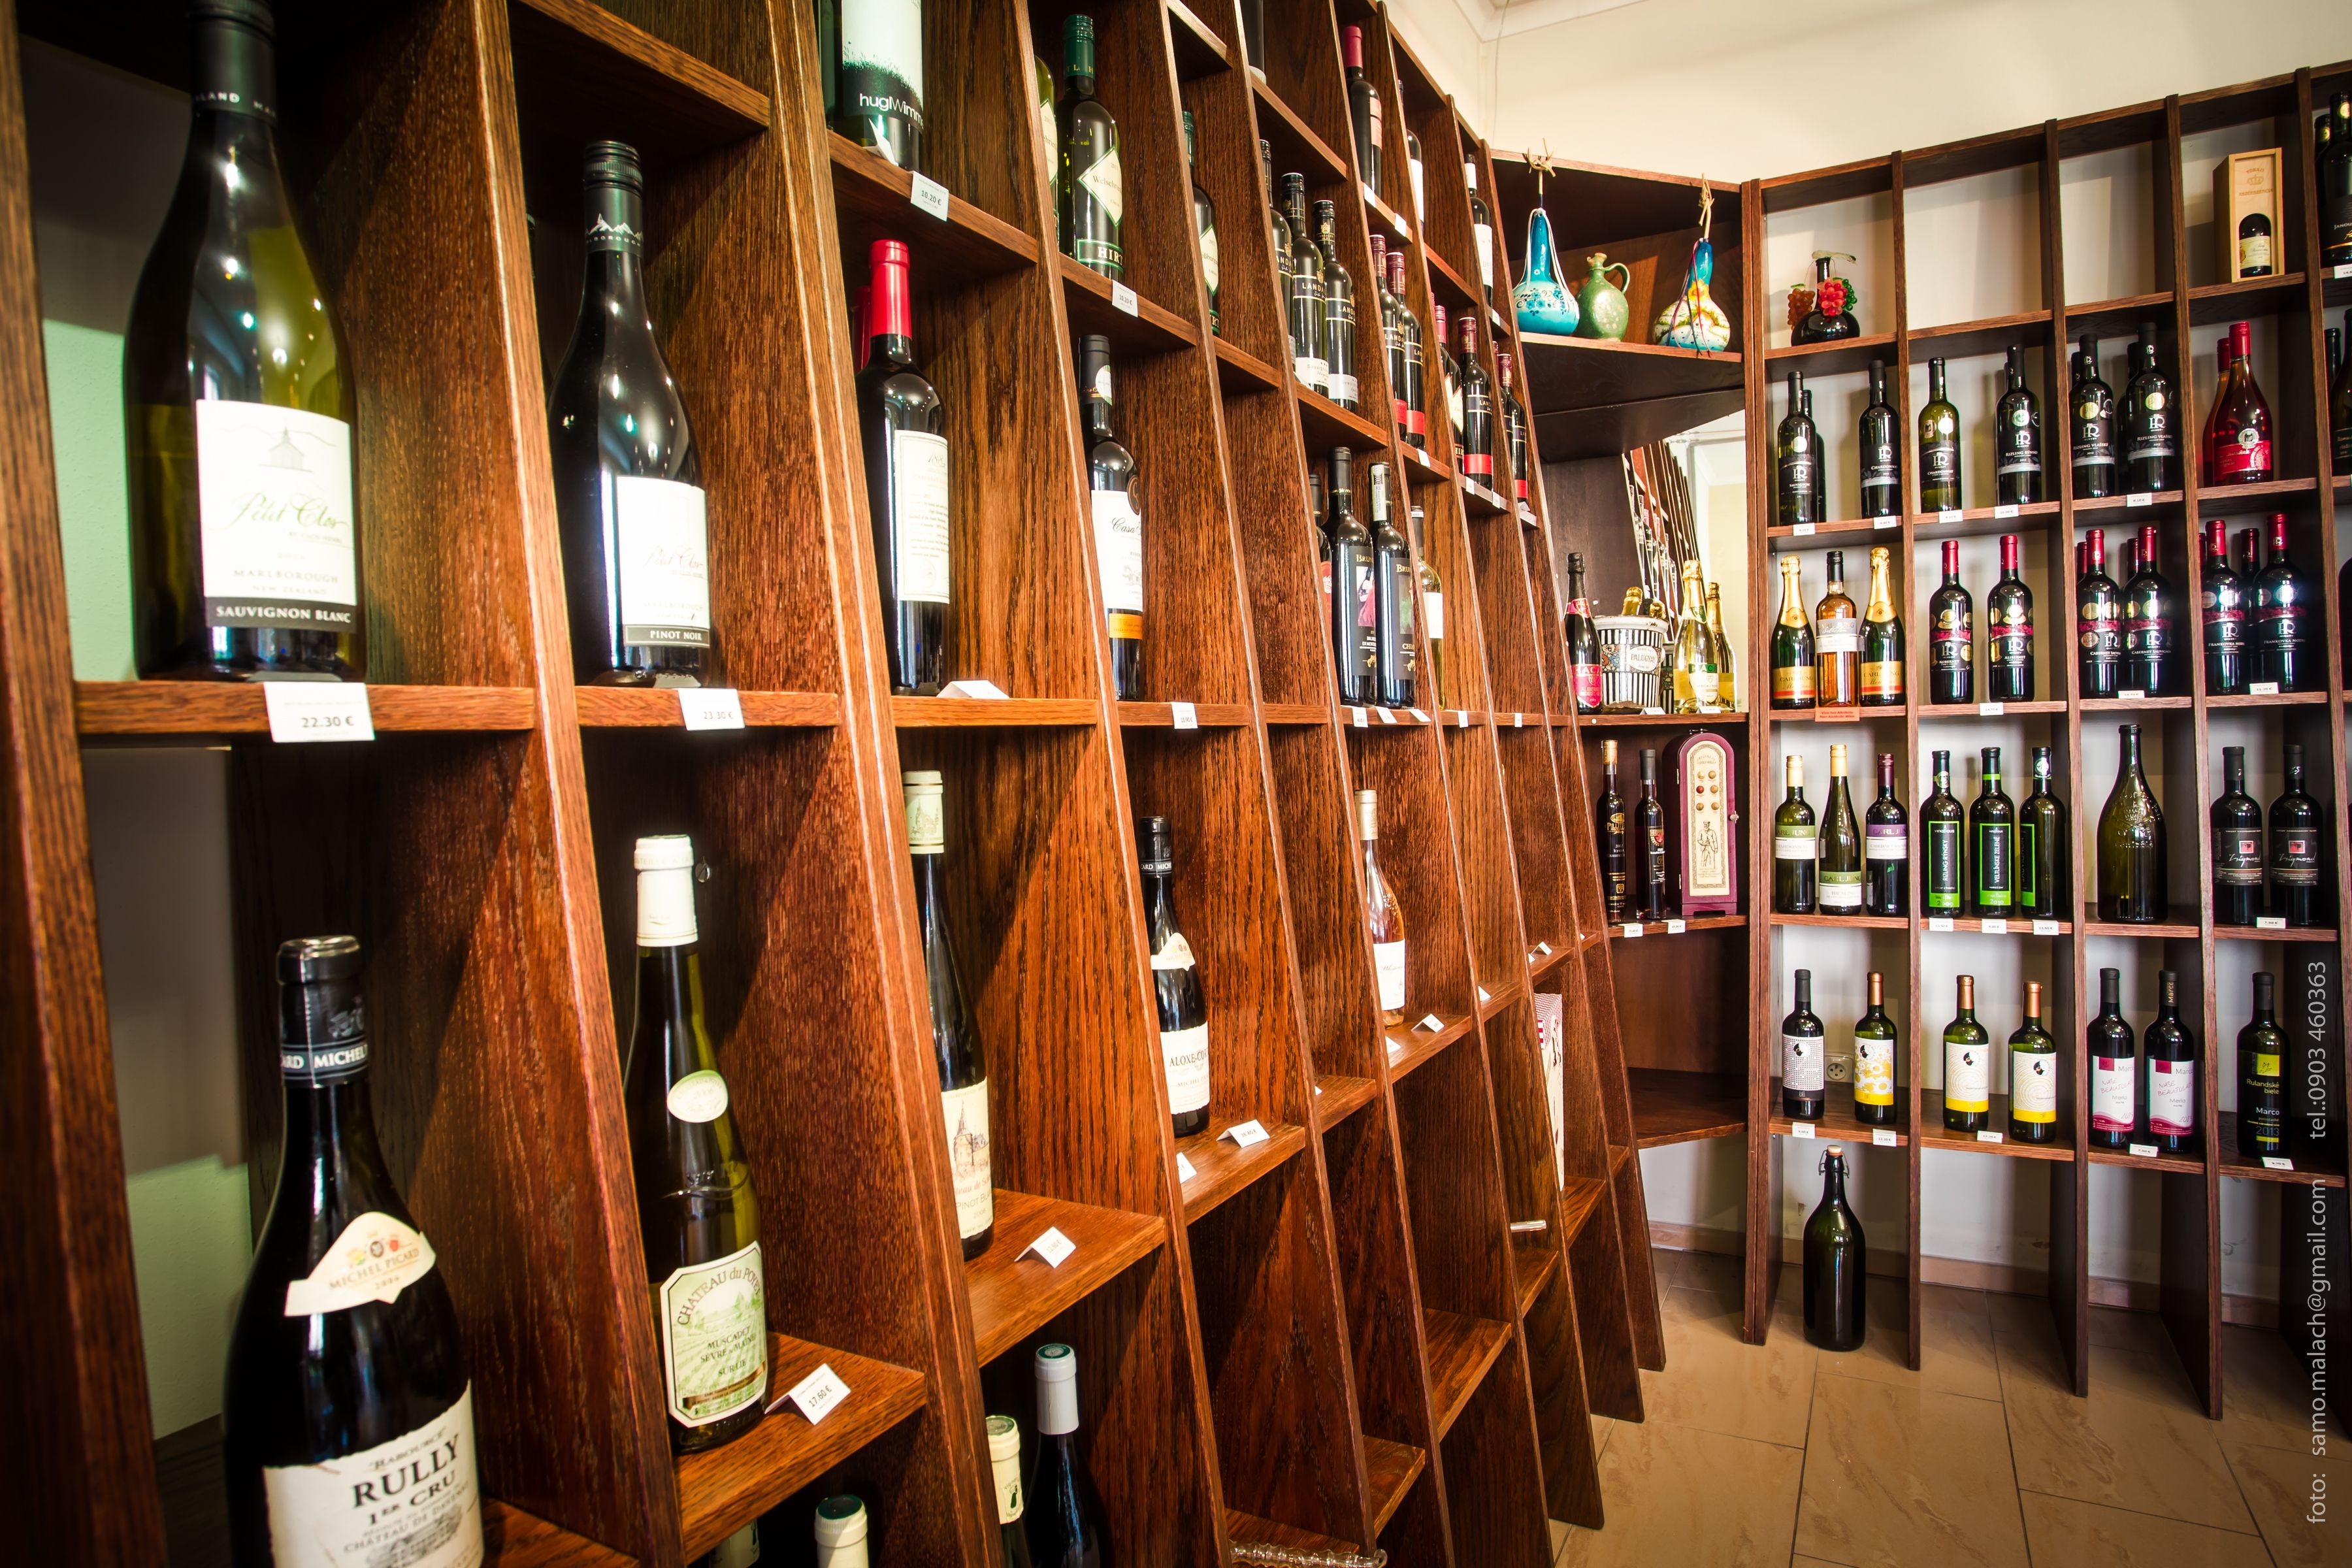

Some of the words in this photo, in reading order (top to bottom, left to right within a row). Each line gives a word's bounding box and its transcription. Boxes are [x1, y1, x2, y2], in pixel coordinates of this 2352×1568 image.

[921, 189, 937, 204] 10.20
[290, 491, 349, 530] Clos
[233, 569, 338, 583] MARLBOROUGH
[216, 606, 310, 619] SAUVIGNON
[316, 610, 351, 623] BLANC
[650, 630, 680, 640] PINOT
[683, 631, 702, 640] NOIR
[301, 715, 342, 728] 22.30
[345, 715, 355, 727] €
[703, 711, 727, 720] 23.30
[2246, 1078, 2279, 1088] Rulandské
[2256, 1107, 2279, 1116] Marco
[2255, 1125, 2279, 1137] 2013
[329, 1260, 382, 1292] MICHEL
[385, 1249, 419, 1271] PICARD
[678, 1267, 727, 1326] CHATEAU
[729, 1267, 742, 1281] du
[707, 1325, 752, 1350] MUSCADET
[718, 1364, 735, 1377] SUR
[736, 1358, 747, 1371] LIE
[808, 1389, 828, 1408] 17.60
[351, 1432, 459, 1509] RULLY
[410, 1469, 457, 1507] CRU
